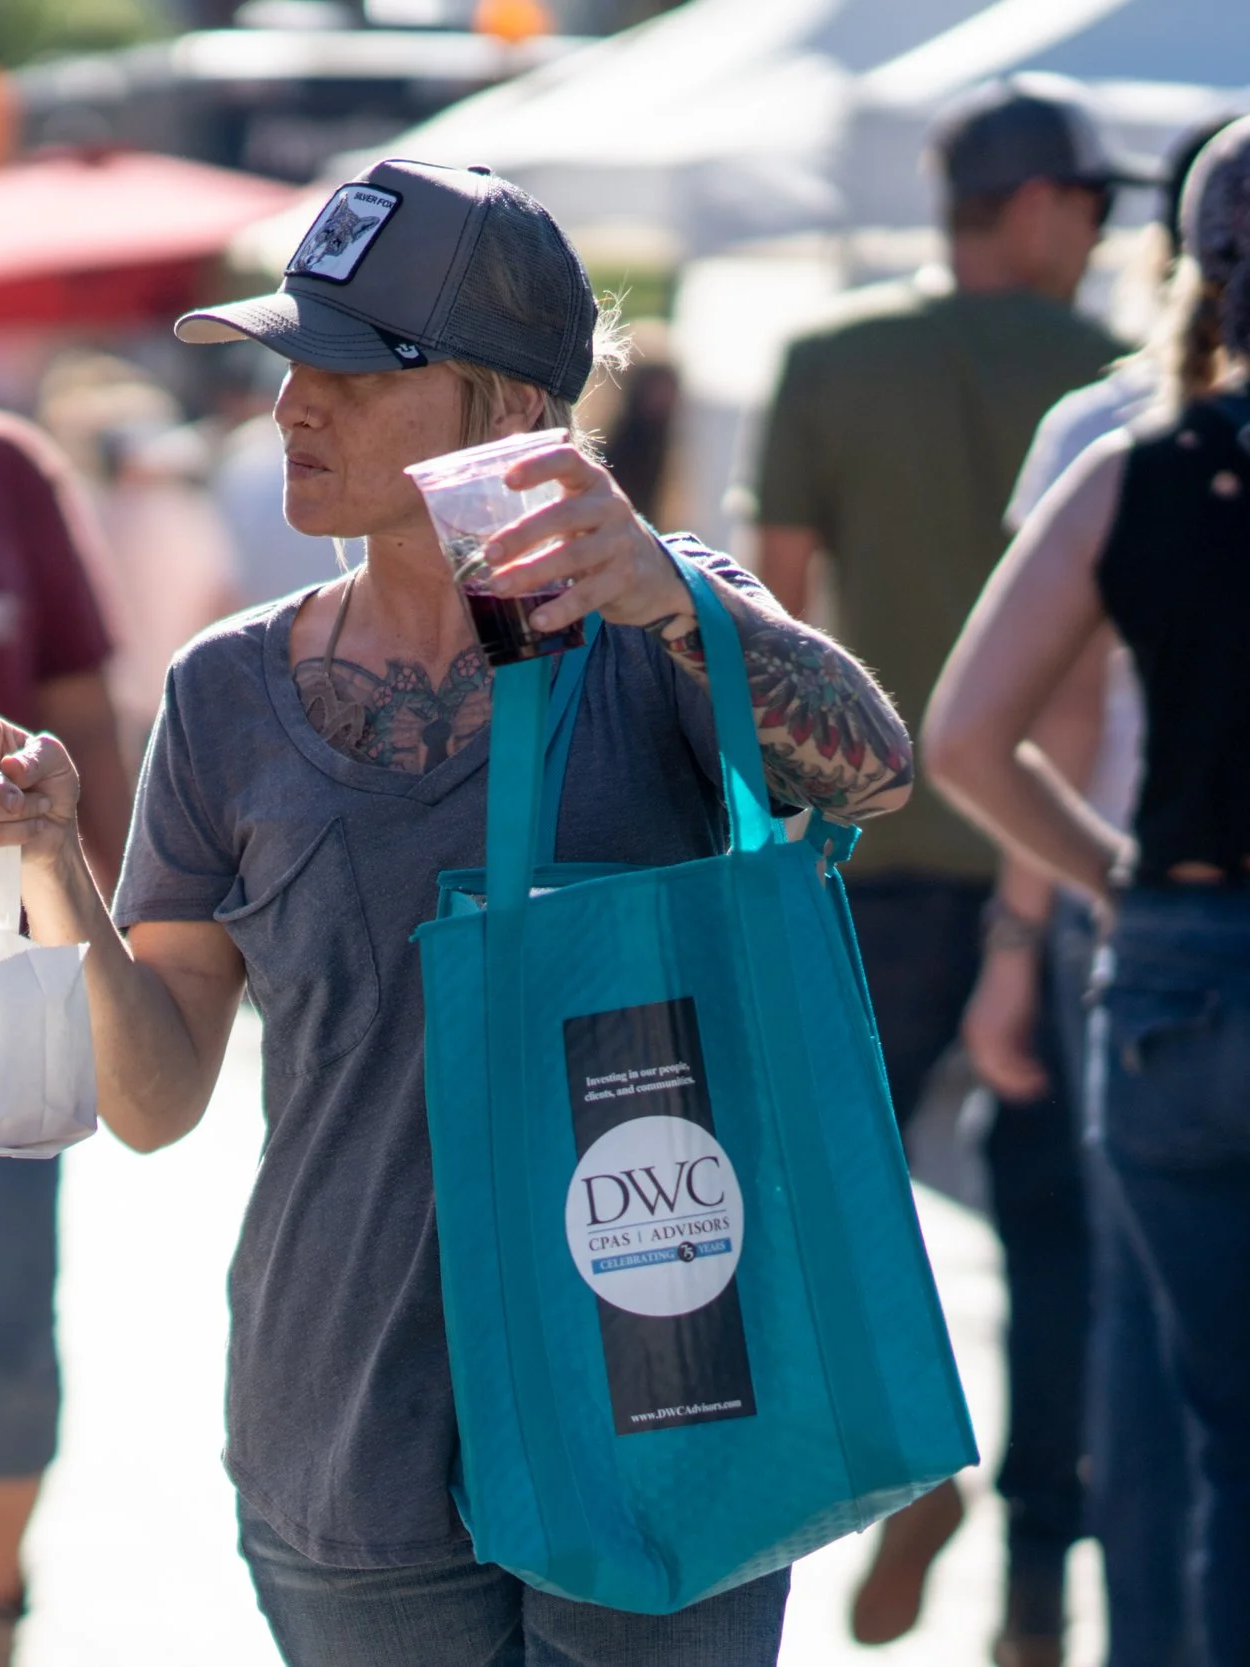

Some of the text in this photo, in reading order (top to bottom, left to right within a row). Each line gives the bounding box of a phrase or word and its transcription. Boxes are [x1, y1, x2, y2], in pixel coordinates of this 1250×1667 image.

[354, 191, 393, 209] SILVER FOX
[586, 1061, 691, 1087] Investing in our people,
[584, 1076, 696, 1102] clients, and communities.
[581, 1156, 725, 1226] DWC
[588, 1216, 730, 1251] CPAS ADVISORS
[599, 1241, 727, 1271] CELEBRATING 75 YEARS
[630, 1399, 742, 1423] www.DWCAdvisors.com
